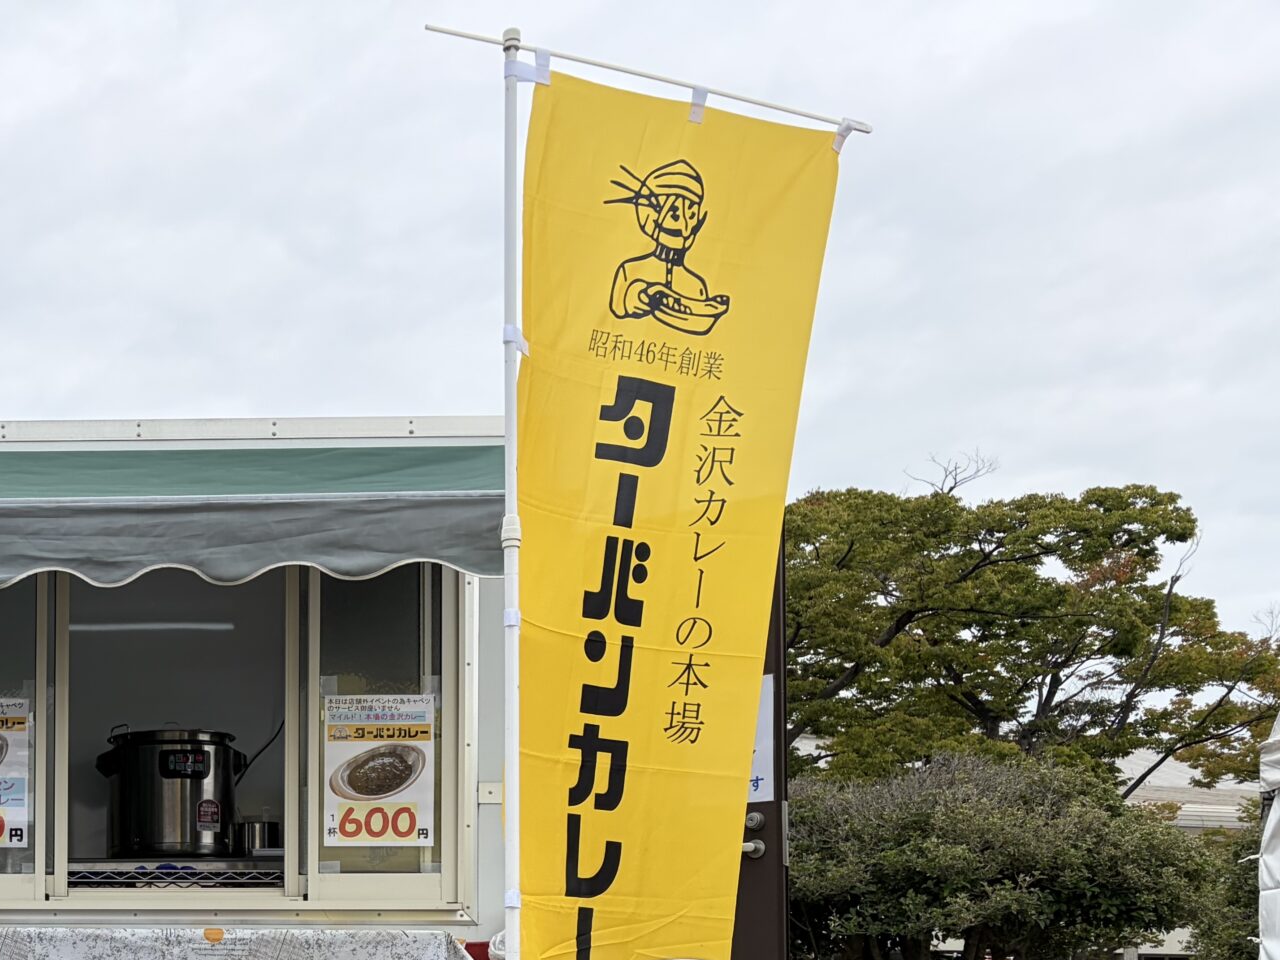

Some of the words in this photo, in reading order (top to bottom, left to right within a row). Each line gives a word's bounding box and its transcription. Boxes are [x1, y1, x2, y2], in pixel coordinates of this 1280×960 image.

[588, 328, 725, 381] 昭和46年創業
[663, 395, 744, 745] 金沢カレーの本場
[354, 727, 429, 739] ターバンカレー
